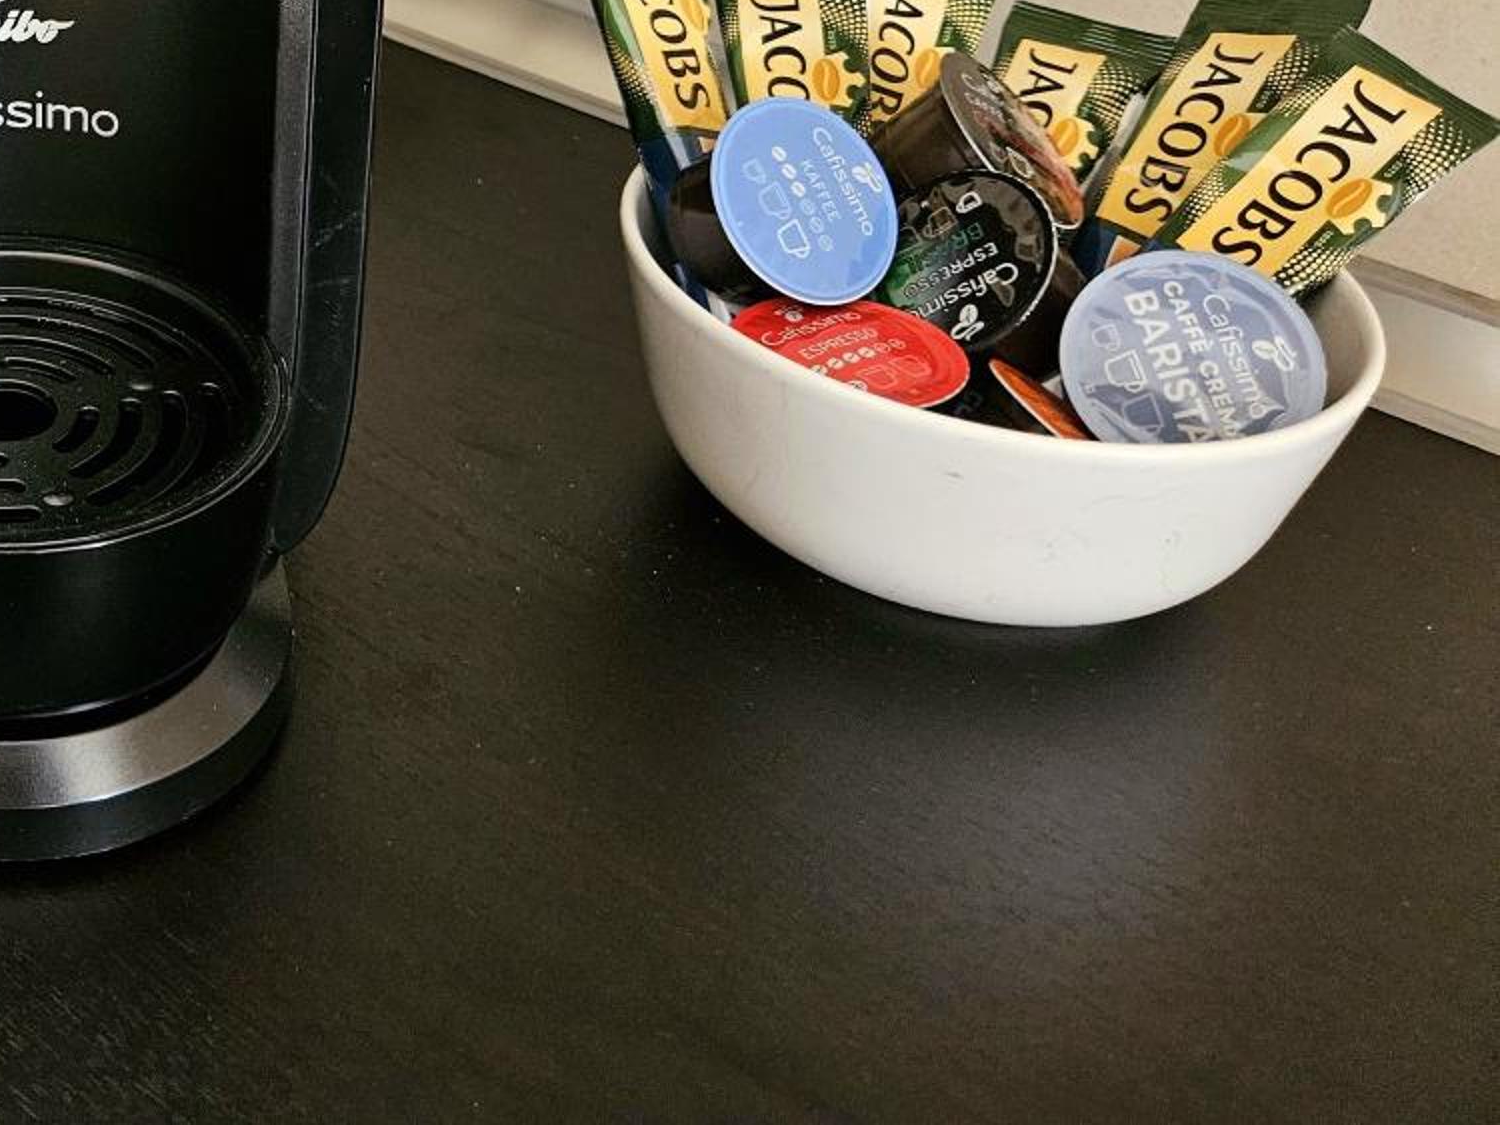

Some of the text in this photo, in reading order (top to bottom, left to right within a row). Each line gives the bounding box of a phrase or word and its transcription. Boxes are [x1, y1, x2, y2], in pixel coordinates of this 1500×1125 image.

[1019, 48, 1080, 129] JAC
[1124, 42, 1265, 222] JACOBS
[802, 159, 841, 223] KAFFEE
[813, 126, 874, 236] Cafissimo
[1211, 79, 1408, 266] JACOBS
[903, 242, 999, 298] ESPRESSO
[761, 310, 862, 346] Cafissimo
[798, 327, 879, 360] ESPRESSO
[1162, 279, 1212, 355] CAFFÈ
[1201, 293, 1267, 421] Cafissimo
